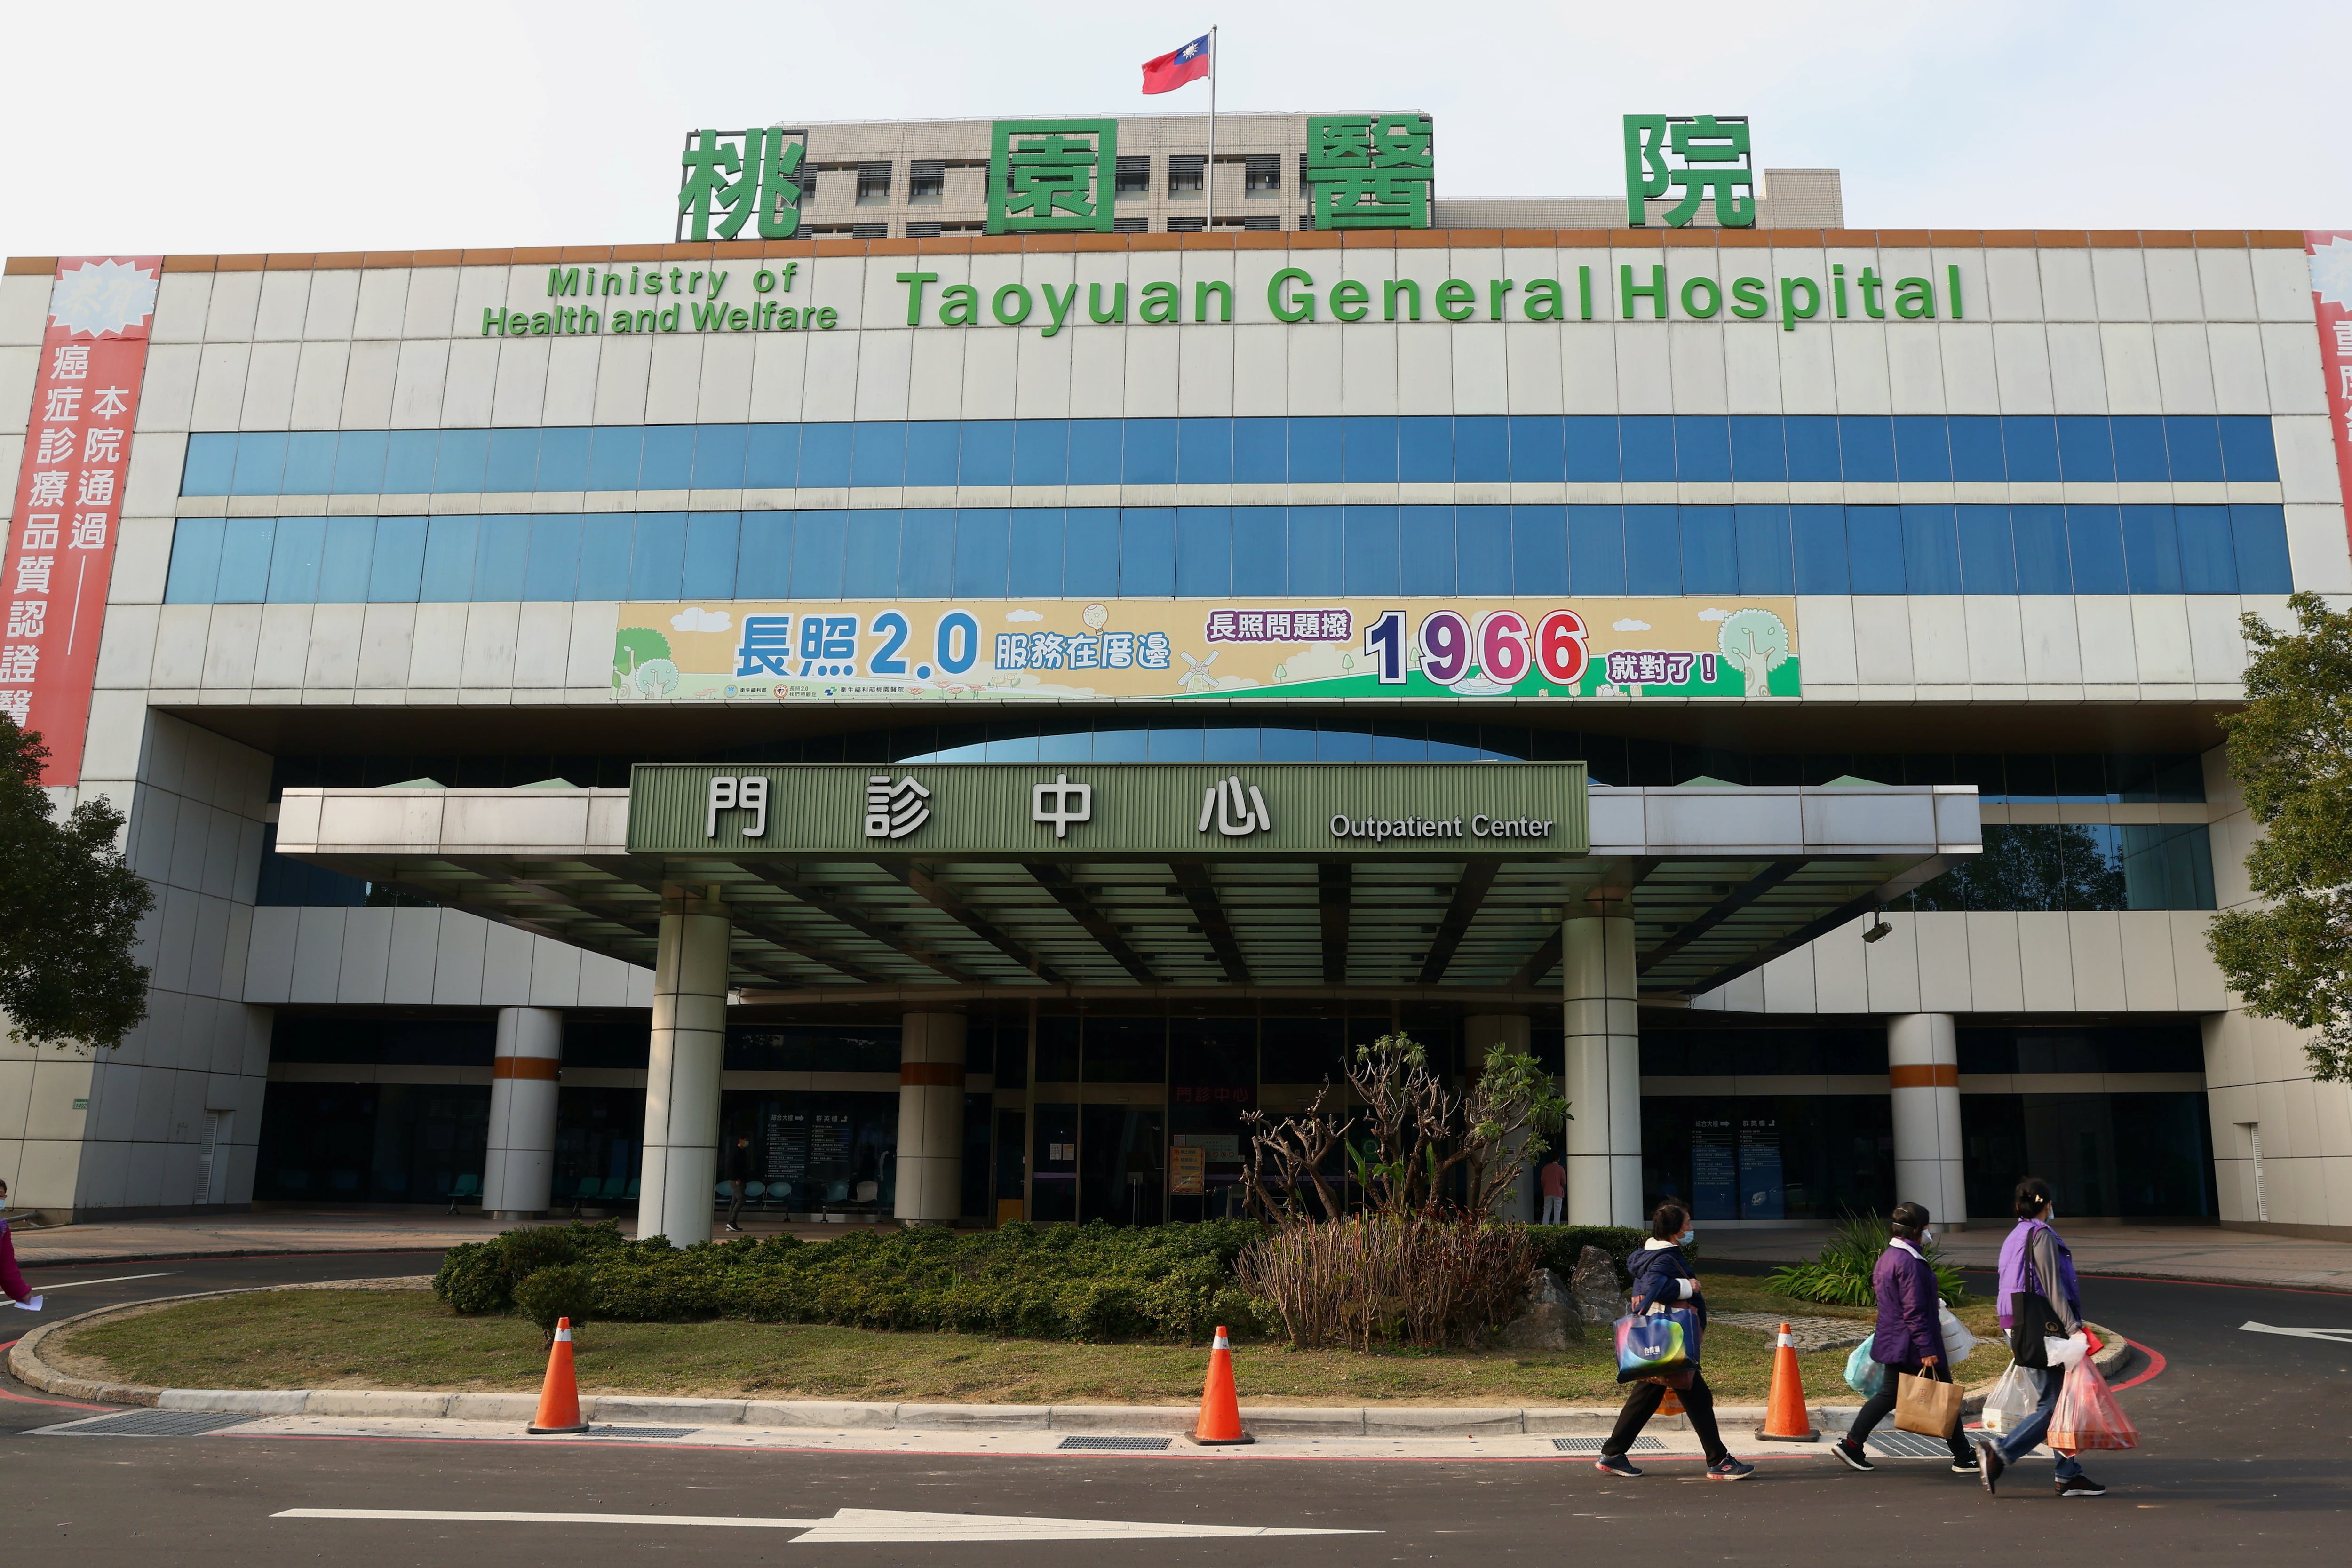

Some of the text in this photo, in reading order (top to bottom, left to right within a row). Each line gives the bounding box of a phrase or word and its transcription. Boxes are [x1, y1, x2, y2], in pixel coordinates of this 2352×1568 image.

[678, 115, 1756, 242] 桃園醫院
[547, 262, 797, 300] Ministry of
[896, 264, 1963, 337] Taoyuan General Hospital
[481, 300, 838, 336] Health and Welfare
[737, 613, 978, 680] 長照2.0
[1208, 613, 1350, 640] 長照問題撥
[1367, 611, 1588, 683] 1966
[706, 773, 1271, 839] 門診中心
[1329, 814, 1553, 842] Outpatient Center
[1176, 1086, 1249, 1102] 門診中心
